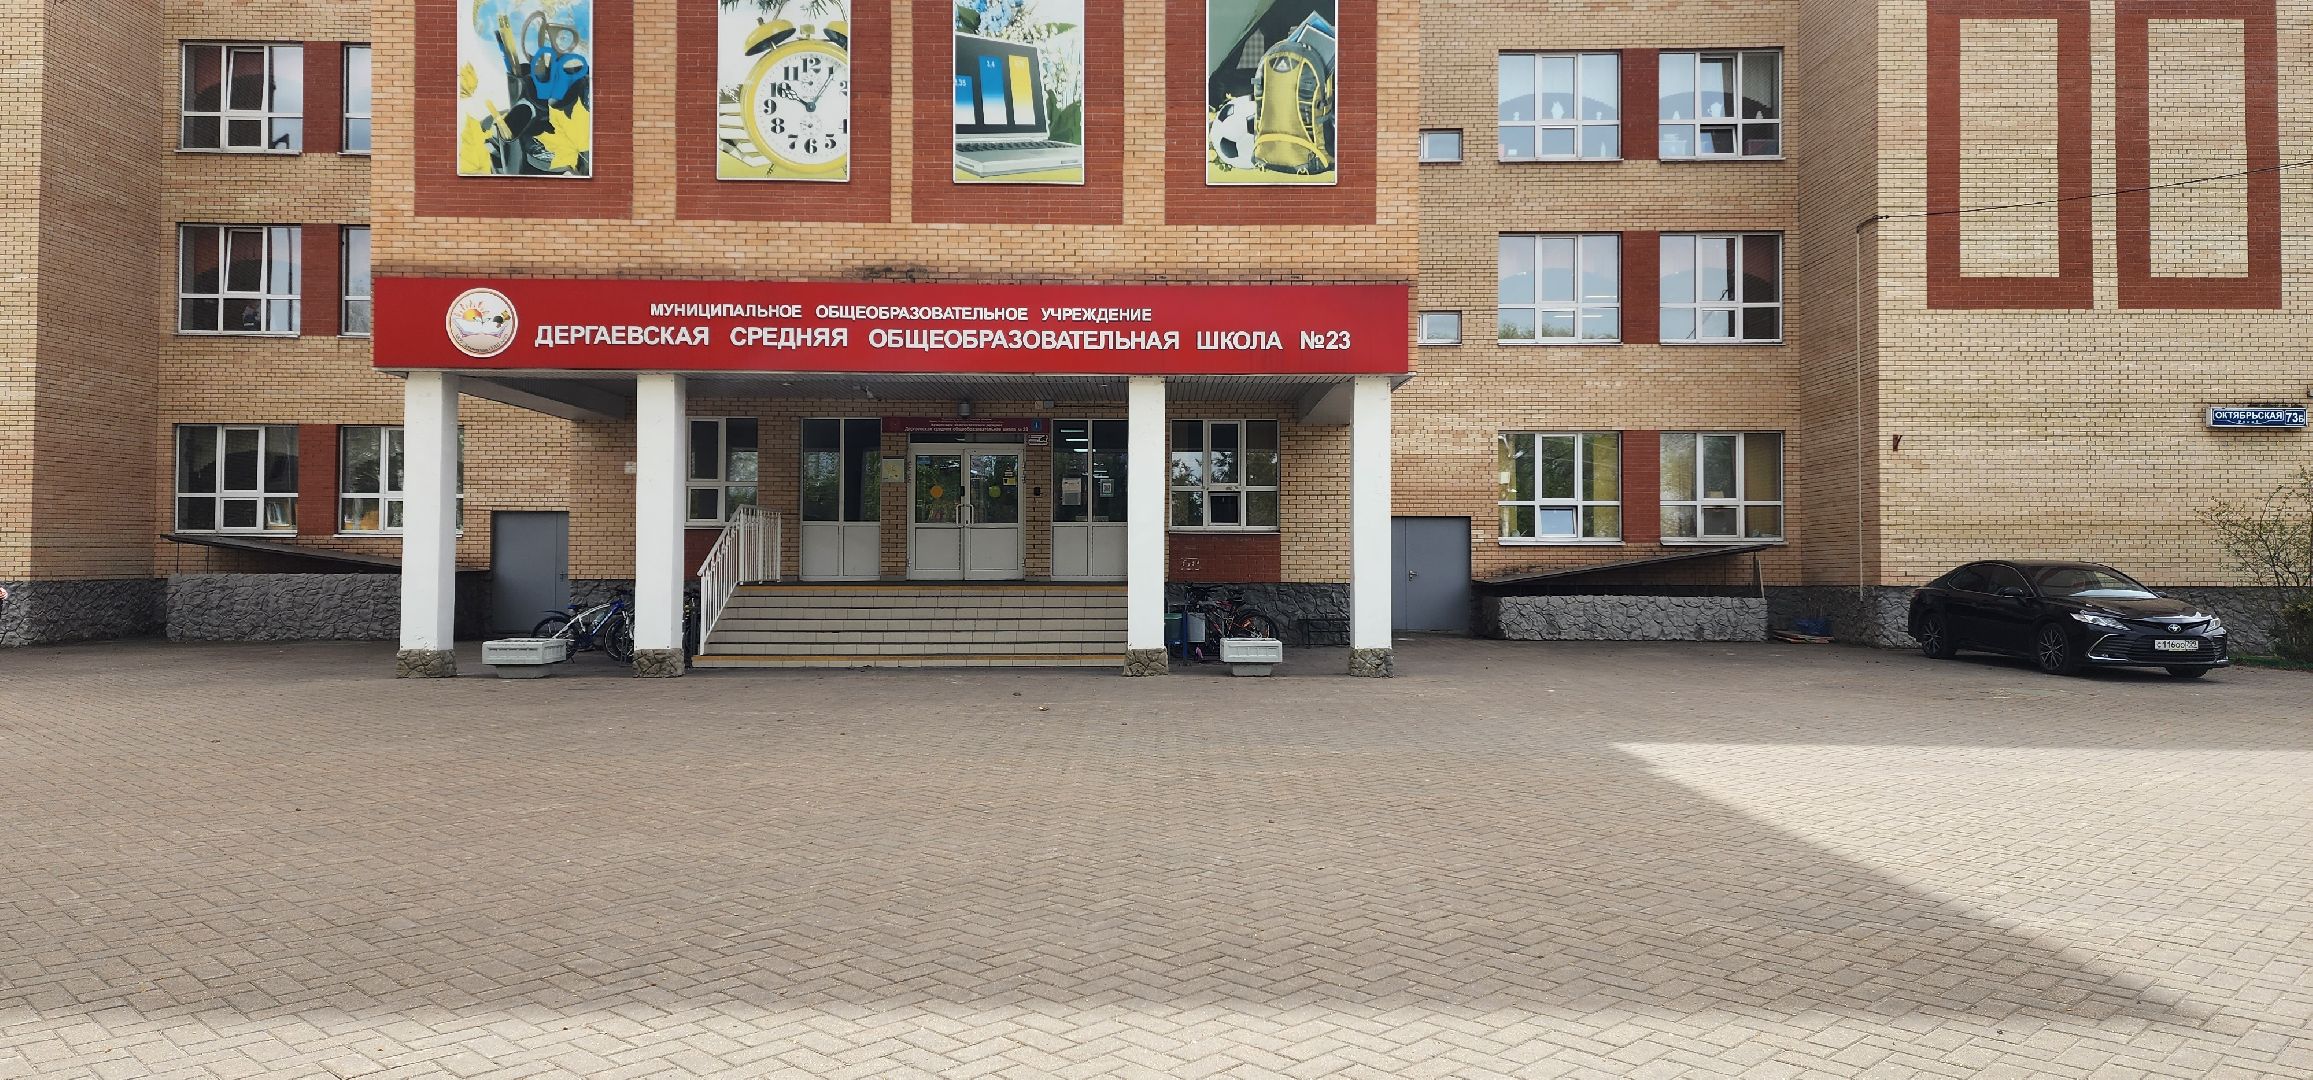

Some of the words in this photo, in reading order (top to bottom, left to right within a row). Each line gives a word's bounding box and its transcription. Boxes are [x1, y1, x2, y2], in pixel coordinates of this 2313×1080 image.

[783, 66, 799, 81] 11
[802, 57, 821, 74] 12
[763, 99, 777, 115] 9
[770, 117, 785, 134] 8
[787, 134, 798, 150] 7
[803, 138, 818, 154] 6
[824, 133, 837, 149] 5
[650, 303, 803, 320] МУНИЦИПАЛЬНОЕ
[815, 304, 1029, 321] ОБЩЕОБРАЗОВАТЕЛЬНОЕ
[1040, 307, 1152, 322] УЧРЕЖДЕНИЕ
[534, 325, 709, 348] ДЕРГАЕВСКАЯ
[729, 326, 848, 350] СРЕДНЯЯ
[868, 328, 1180, 352] ОБЩЕОБРАЗОВАТЕЛЬНАЯ
[1196, 330, 1284, 350] ШКОЛА
[1300, 330, 1351, 350] №23
[2214, 411, 2283, 420] ОКТЯБРЬСКАЯ
